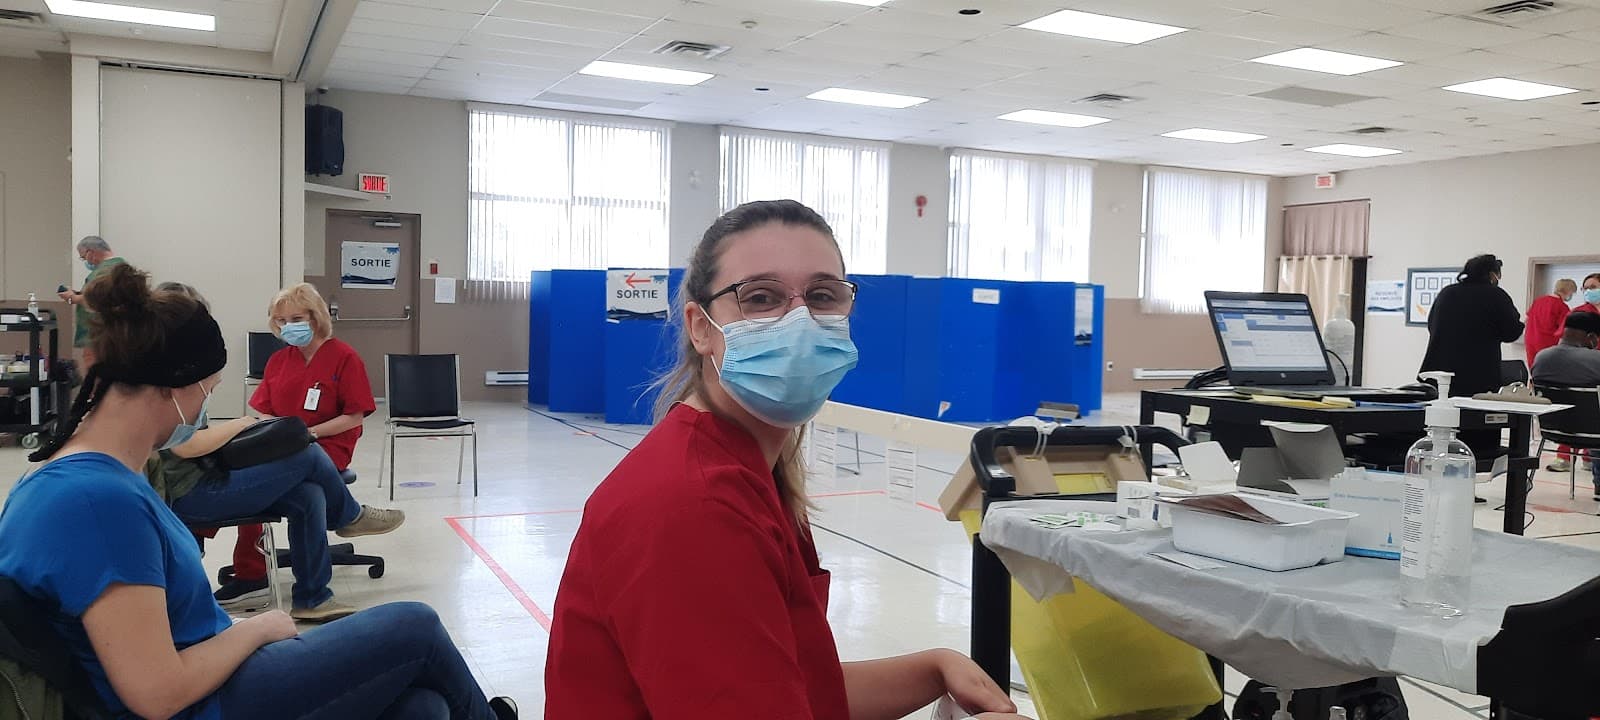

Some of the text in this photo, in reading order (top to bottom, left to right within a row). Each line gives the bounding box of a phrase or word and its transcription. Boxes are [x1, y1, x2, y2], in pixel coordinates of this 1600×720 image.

[362, 175, 386, 191] SORTIE
[351, 258, 391, 267] SORTIE
[616, 289, 658, 299] SORTIE
